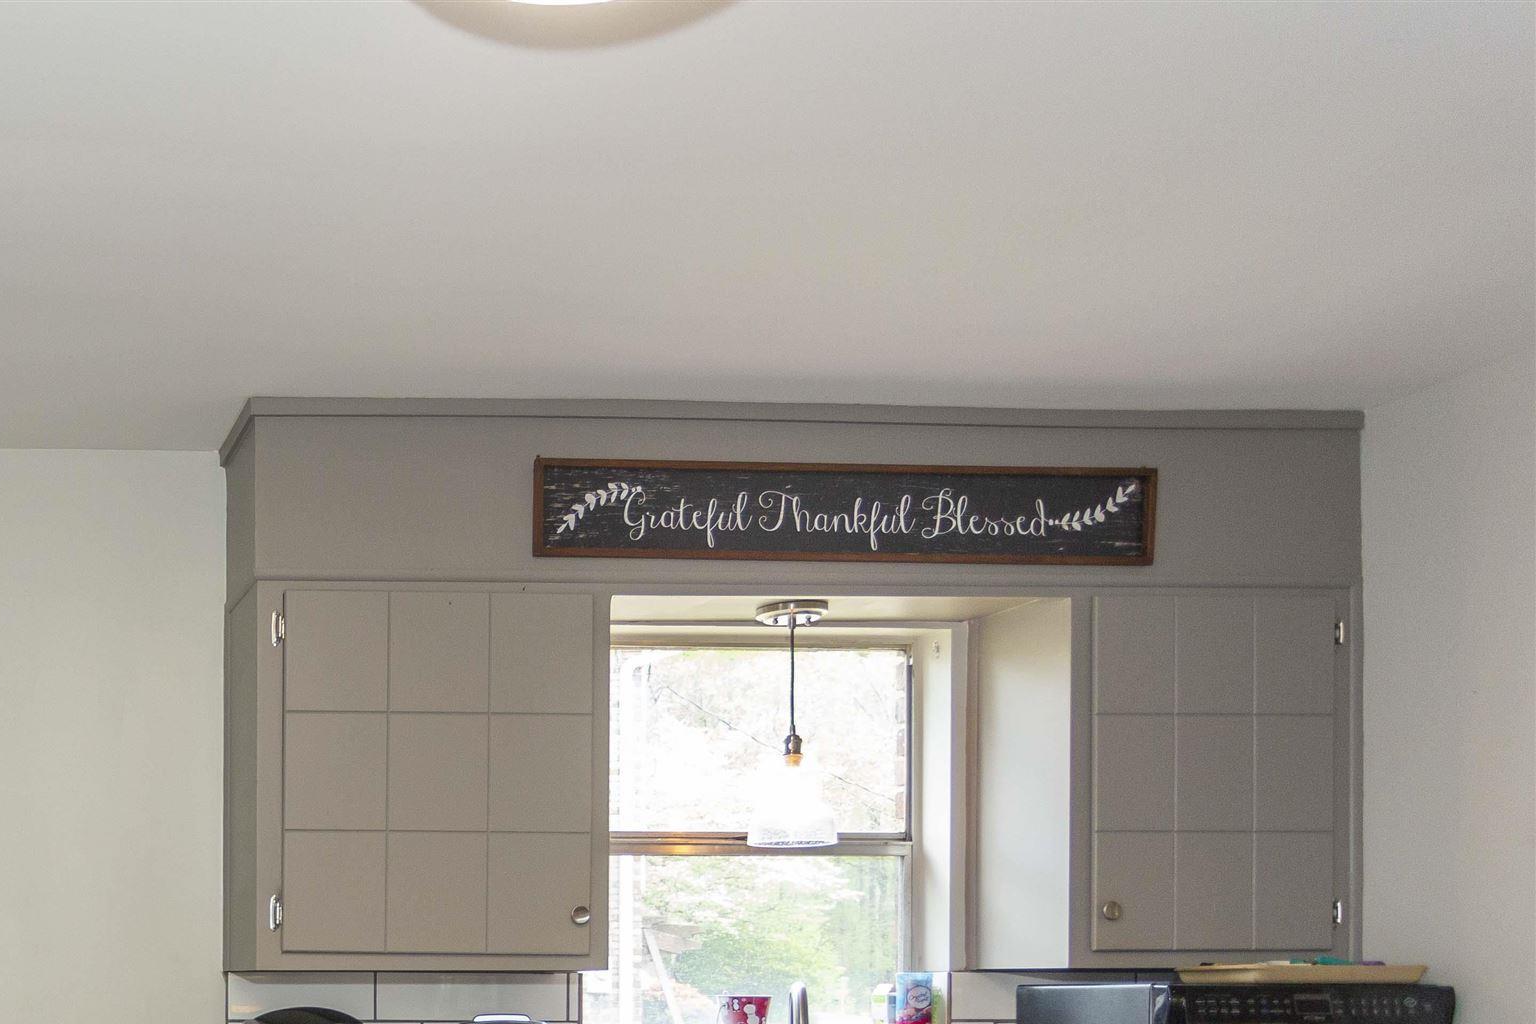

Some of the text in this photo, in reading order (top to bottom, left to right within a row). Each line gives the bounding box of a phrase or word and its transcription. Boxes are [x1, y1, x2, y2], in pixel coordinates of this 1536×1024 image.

[623, 489, 1047, 551] Grateful Thankful Blessed
